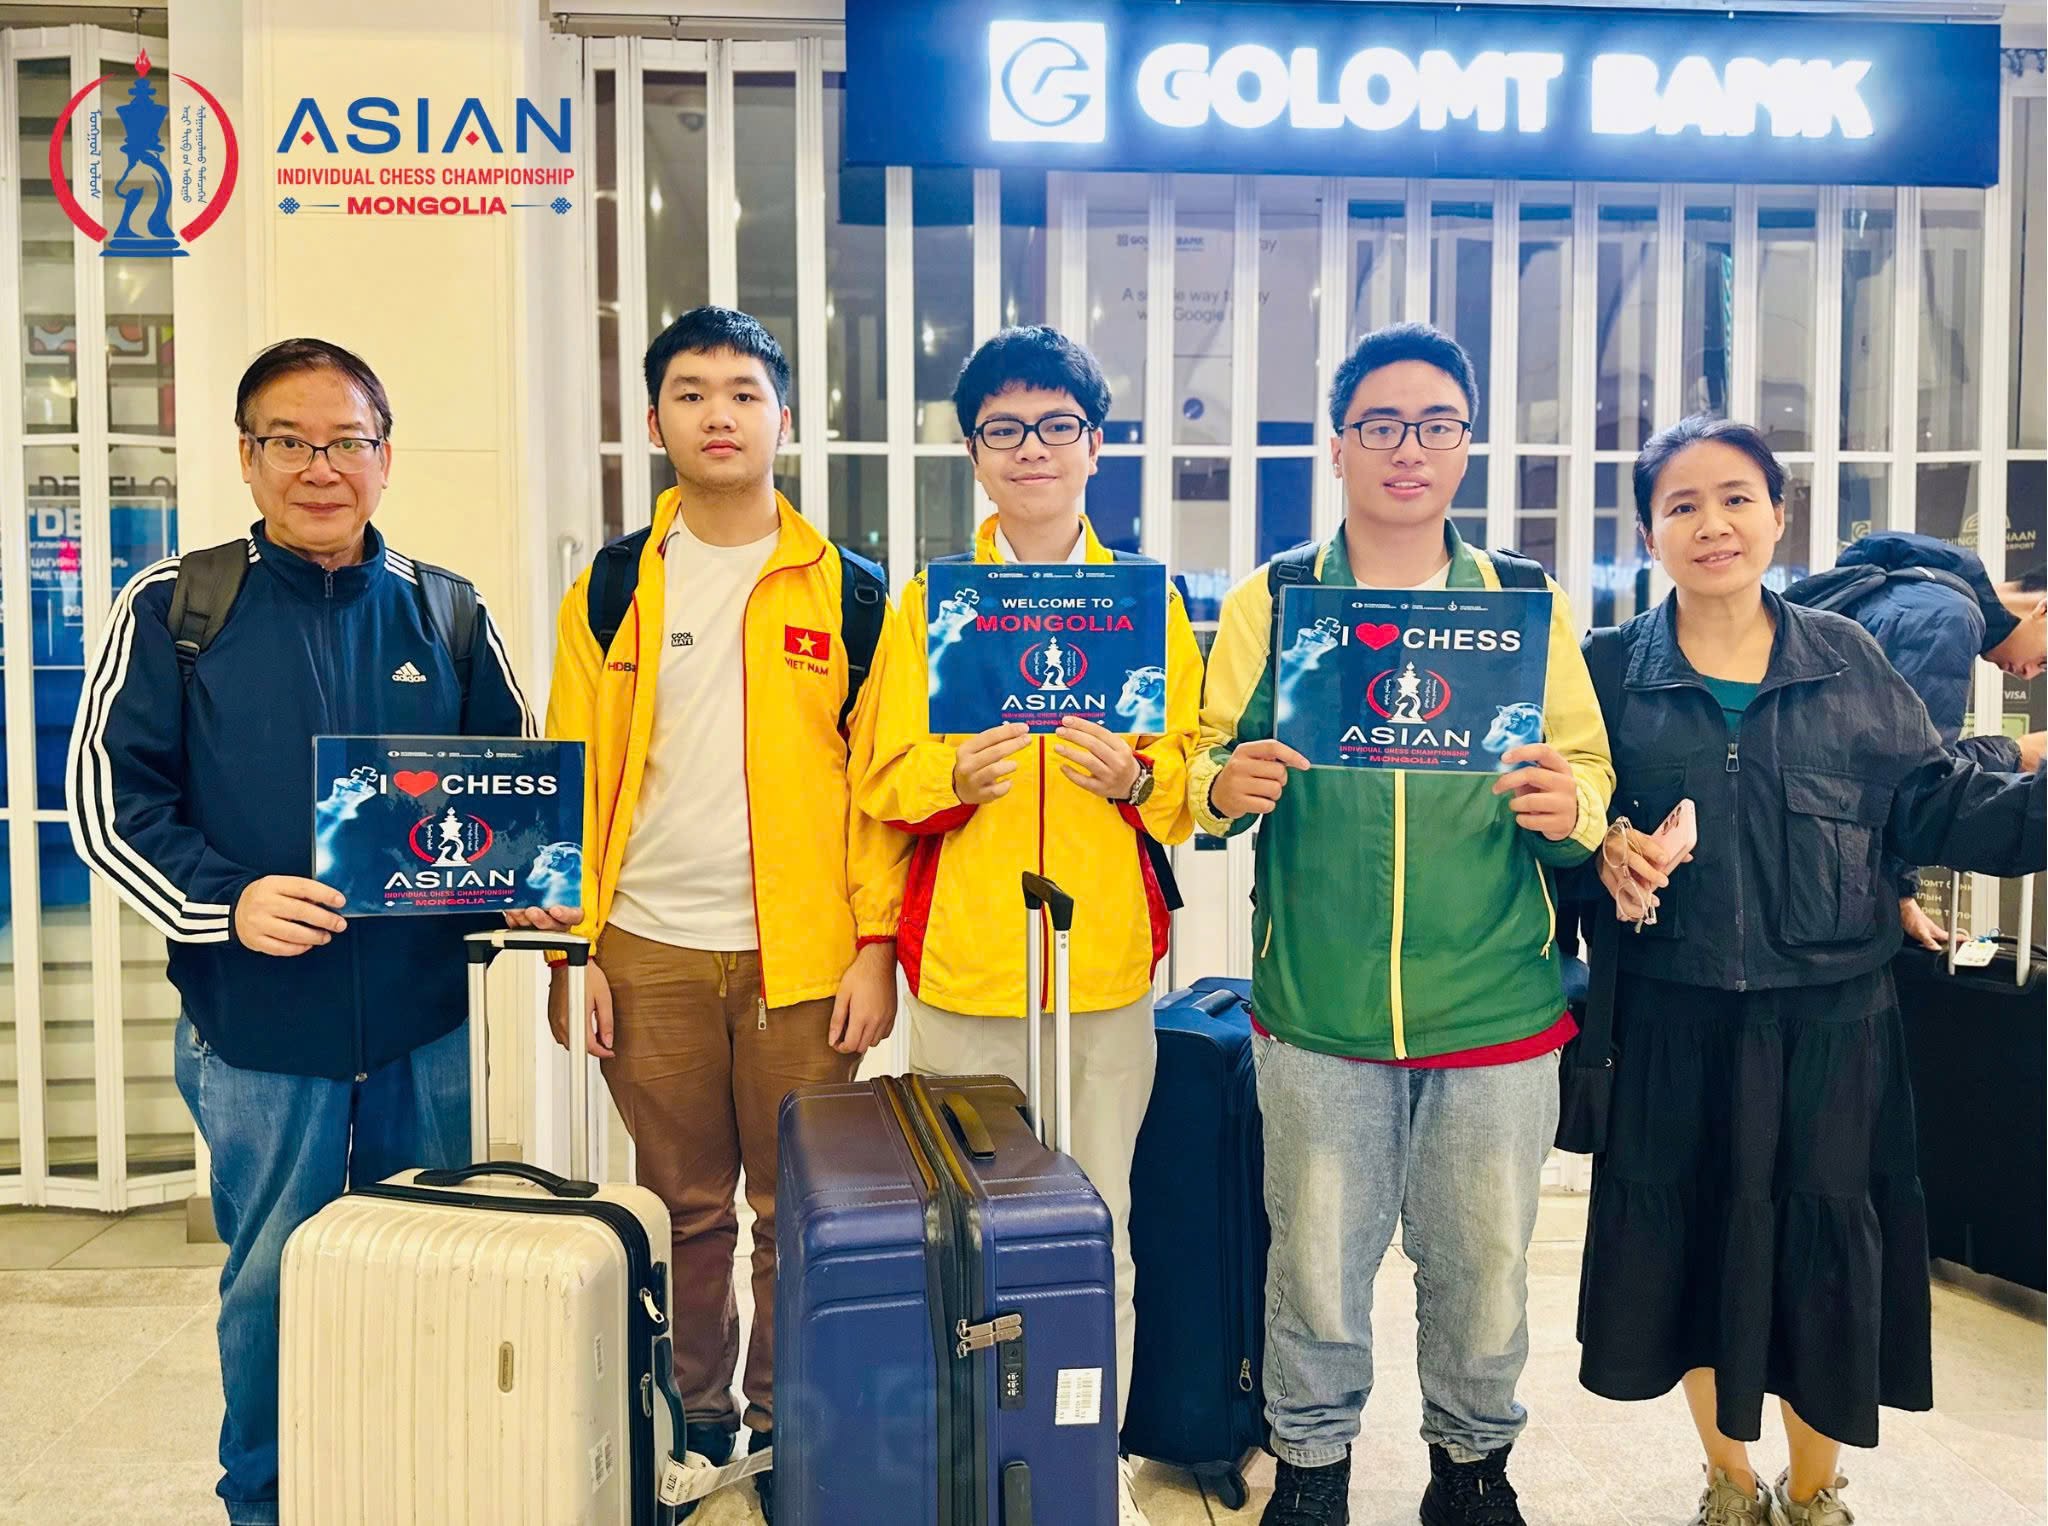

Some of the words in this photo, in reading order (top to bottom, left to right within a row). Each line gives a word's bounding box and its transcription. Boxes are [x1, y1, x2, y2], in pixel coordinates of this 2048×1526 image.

[1136, 42, 1563, 132] GOLOMT
[1590, 53, 1874, 139] BANK
[1174, 306, 1225, 323] Google
[1002, 598, 1086, 609] WELCOME
[1091, 598, 1114, 609] TO
[976, 615, 1135, 632] MONGOLIA
[671, 632, 693, 640] COOL
[1341, 625, 1350, 646] I
[1402, 627, 1521, 652] CHESS
[785, 657, 804, 670] VIET
[807, 662, 829, 676] NAM
[391, 674, 427, 683] adidas
[1001, 694, 1106, 711] ASIAN
[2003, 690, 2027, 700] VISA
[1339, 725, 1471, 748] ASIAN
[1339, 745, 1382, 754] INDIVIDUAL
[1411, 749, 1470, 757] CHAMPIONSHIP
[1369, 755, 1439, 765] MONGOLIA
[379, 774, 387, 795] I
[441, 774, 558, 795] CHESS
[384, 869, 515, 890] ASIAN
[384, 891, 428, 899] INDIVIDUAL
[457, 888, 515, 896] CHAMPIONSHIP
[415, 897, 486, 906] MONGOLIA
